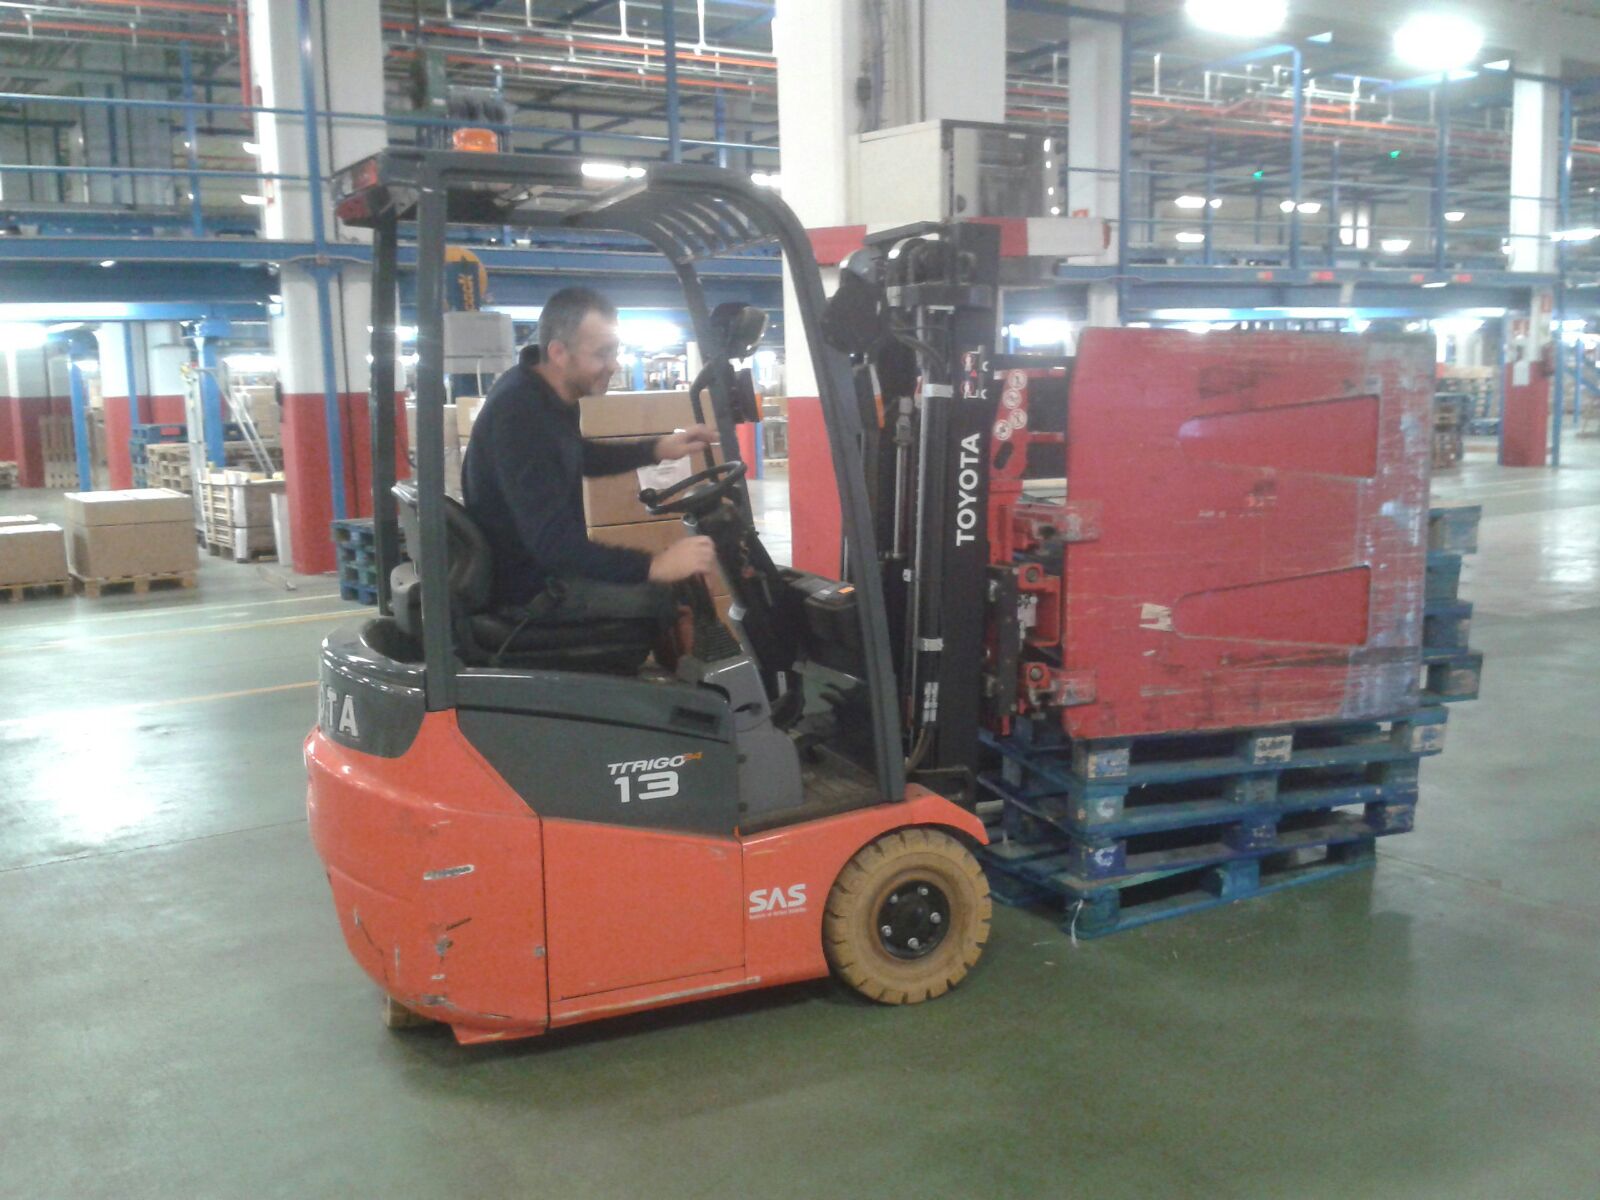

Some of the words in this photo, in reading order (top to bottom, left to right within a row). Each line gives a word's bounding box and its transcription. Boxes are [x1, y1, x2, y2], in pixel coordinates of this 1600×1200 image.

[956, 432, 981, 546] TOYOTA
[320, 684, 359, 737] TA
[614, 770, 679, 803] 13
[749, 883, 807, 913] SAS
